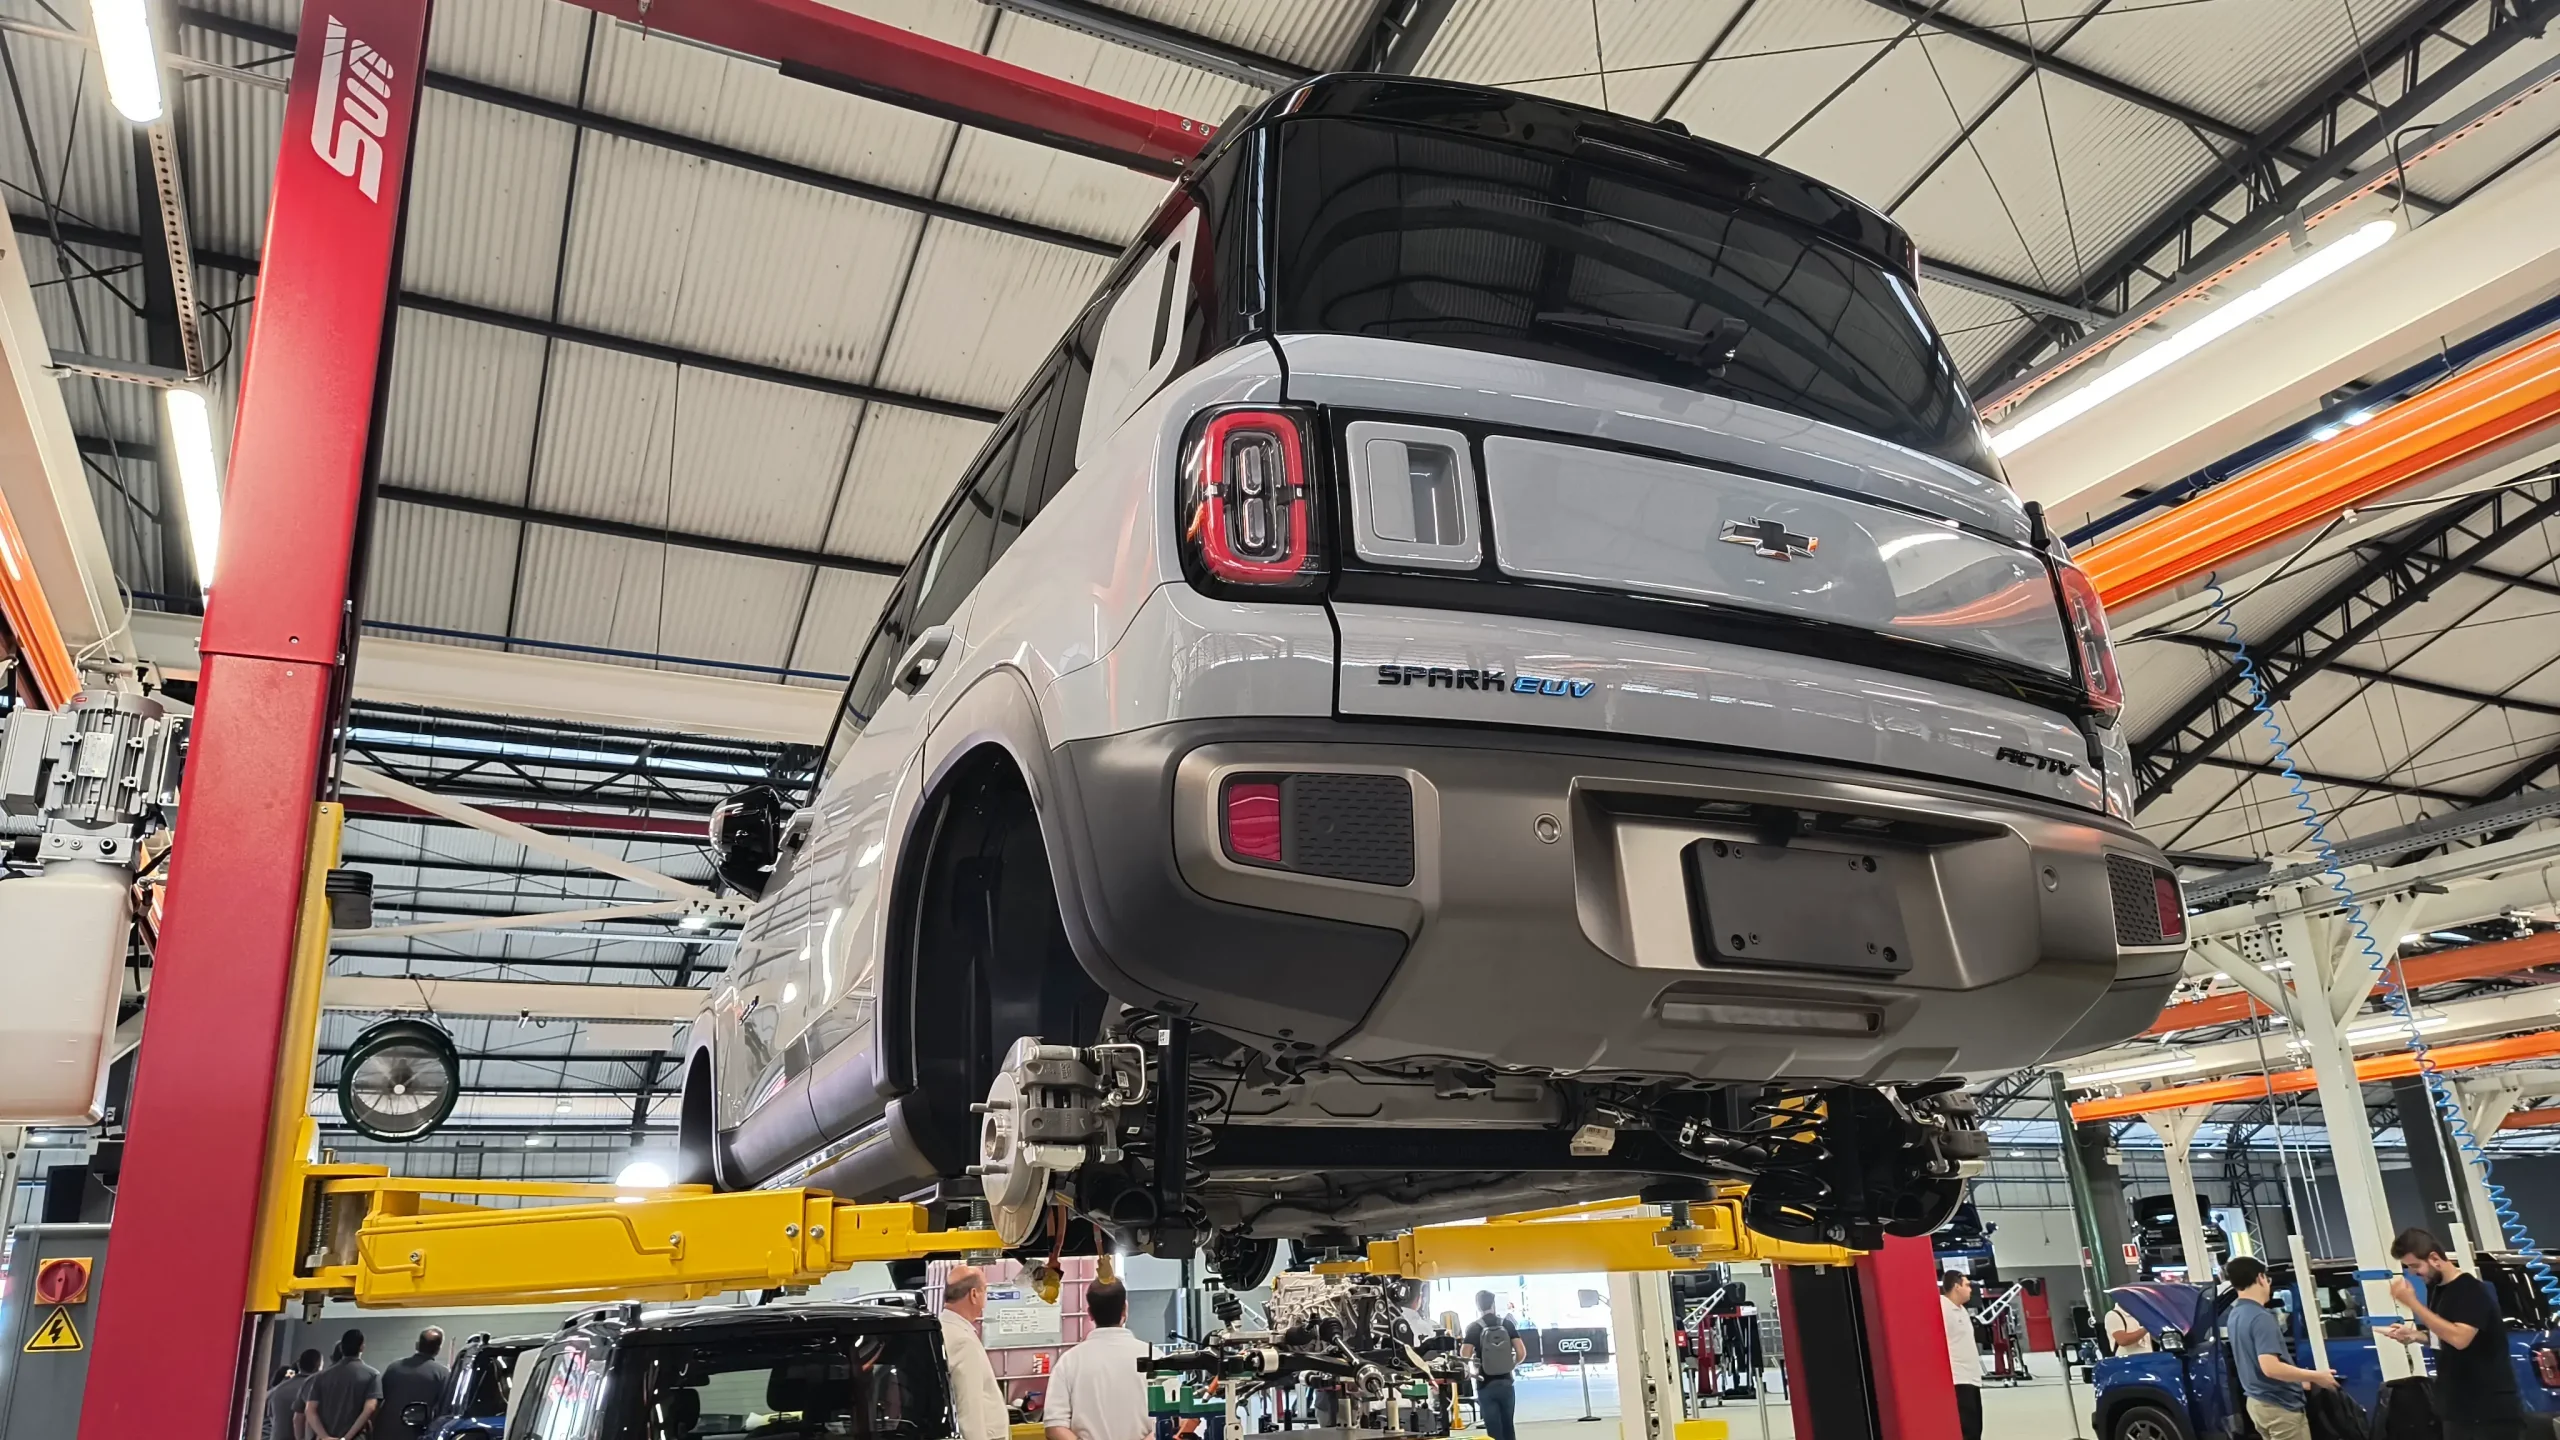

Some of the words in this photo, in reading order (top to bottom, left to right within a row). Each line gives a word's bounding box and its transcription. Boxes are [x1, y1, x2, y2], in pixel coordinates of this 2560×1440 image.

[1378, 665, 1505, 691] SPARK
[1510, 676, 1595, 698] EUV
[1996, 747, 2080, 776] ACTIV
[1562, 1340, 1589, 1350] PACE
